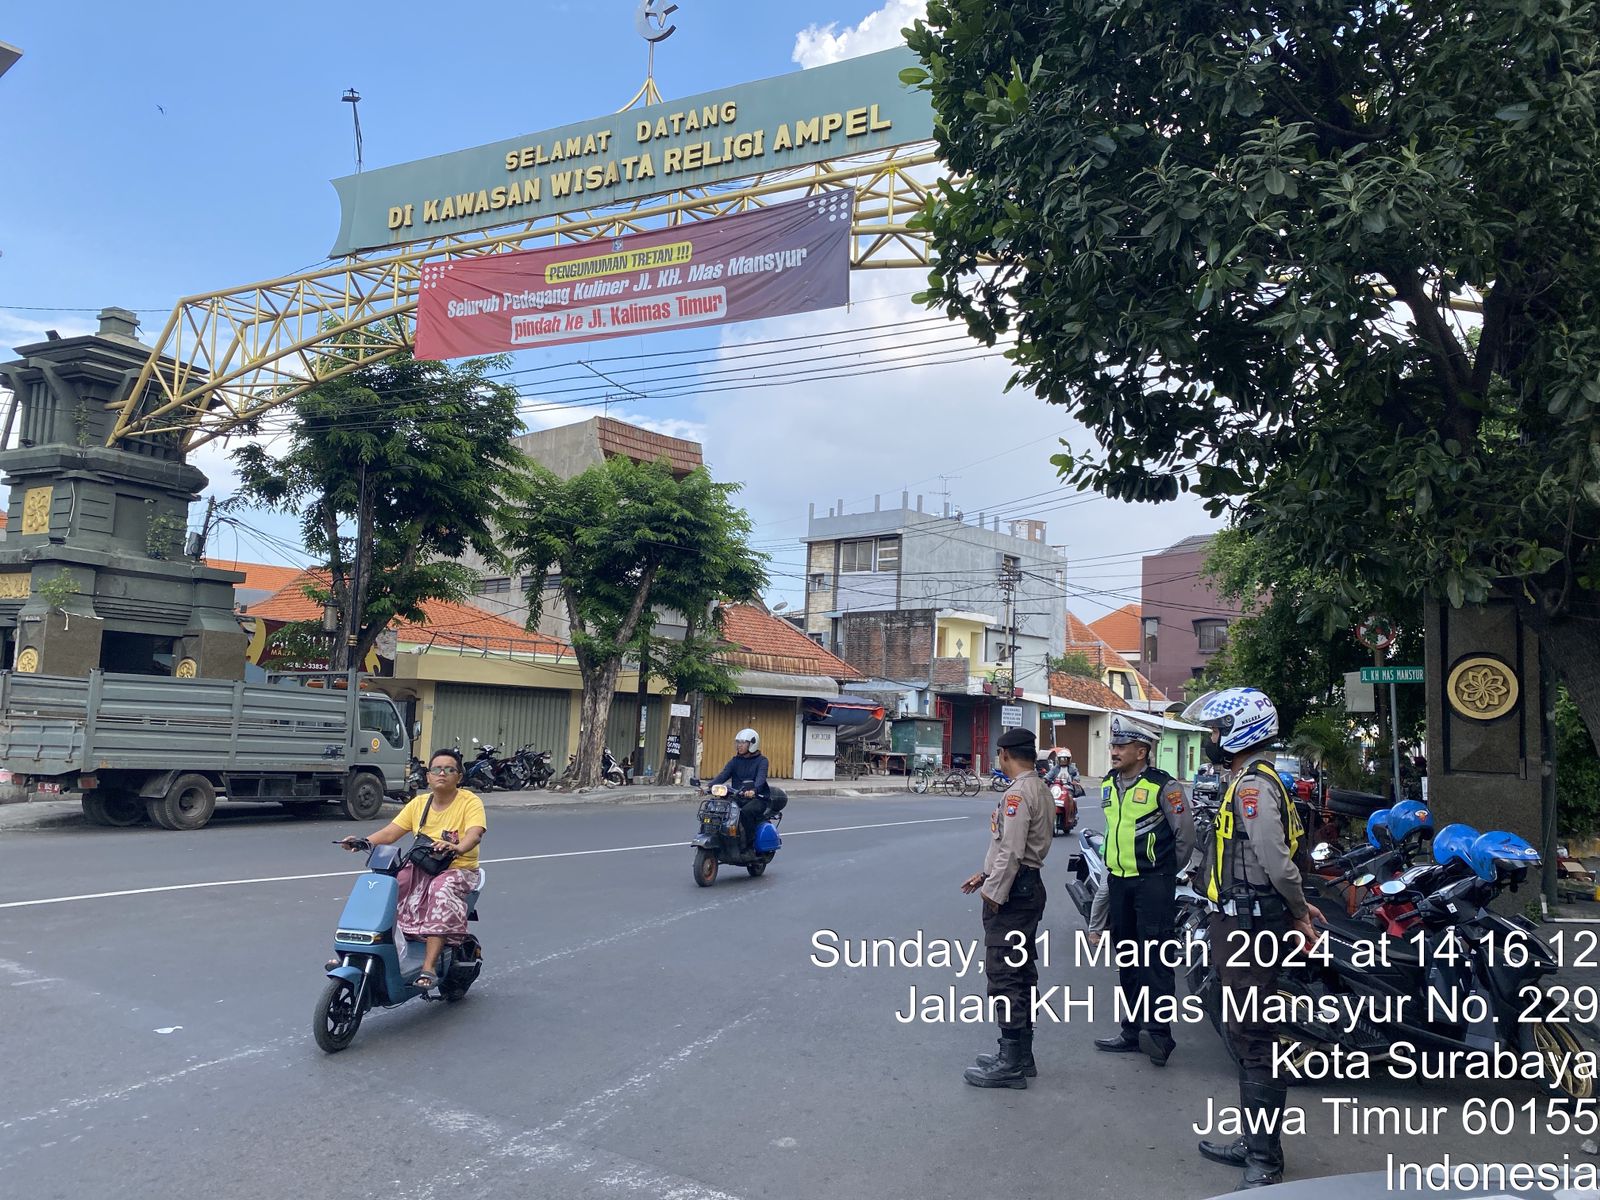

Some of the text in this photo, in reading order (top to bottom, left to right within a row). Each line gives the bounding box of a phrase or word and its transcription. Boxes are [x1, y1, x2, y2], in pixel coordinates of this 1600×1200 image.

[505, 101, 737, 171] SELAMAT DATANG
[388, 103, 892, 230] DI KAWASAN WISATA RELIGI AMPEL
[448, 248, 807, 318] Seluruh Pedagang Kuliner Jl. KH. Mas Mansyur
[550, 254, 628, 280] PENGUMUMAN
[631, 248, 673, 268] TRETAN
[515, 293, 723, 340] pindah ke Jl. Kalimas Timur
[1370, 669, 1380, 681] KH
[1382, 669, 1394, 681] MAS
[1396, 669, 1424, 681] MANSYUR
